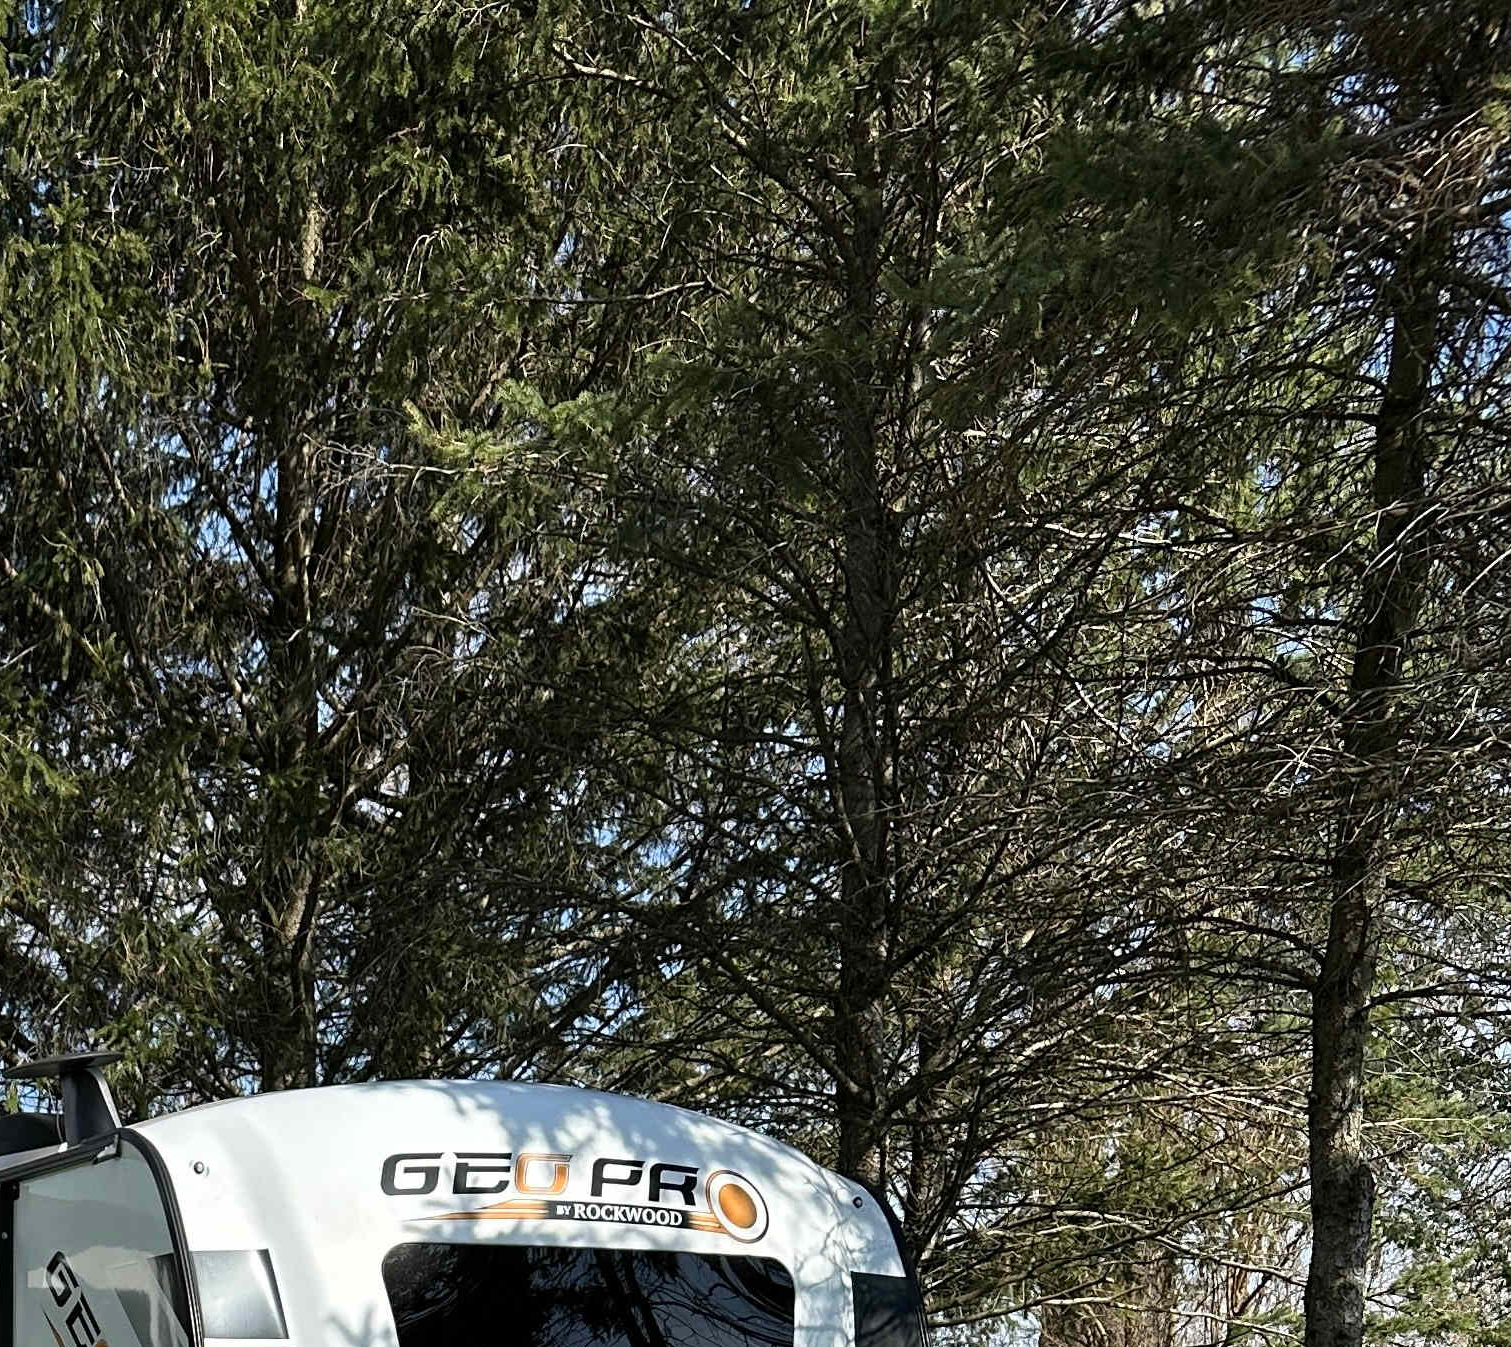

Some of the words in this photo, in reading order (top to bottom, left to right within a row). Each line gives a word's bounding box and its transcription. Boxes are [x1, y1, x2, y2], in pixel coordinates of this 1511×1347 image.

[380, 1152, 573, 1197] GEO
[590, 1157, 770, 1244] PRO
[556, 1205, 571, 1216] BY
[573, 1203, 683, 1227] ROCKWOOD
